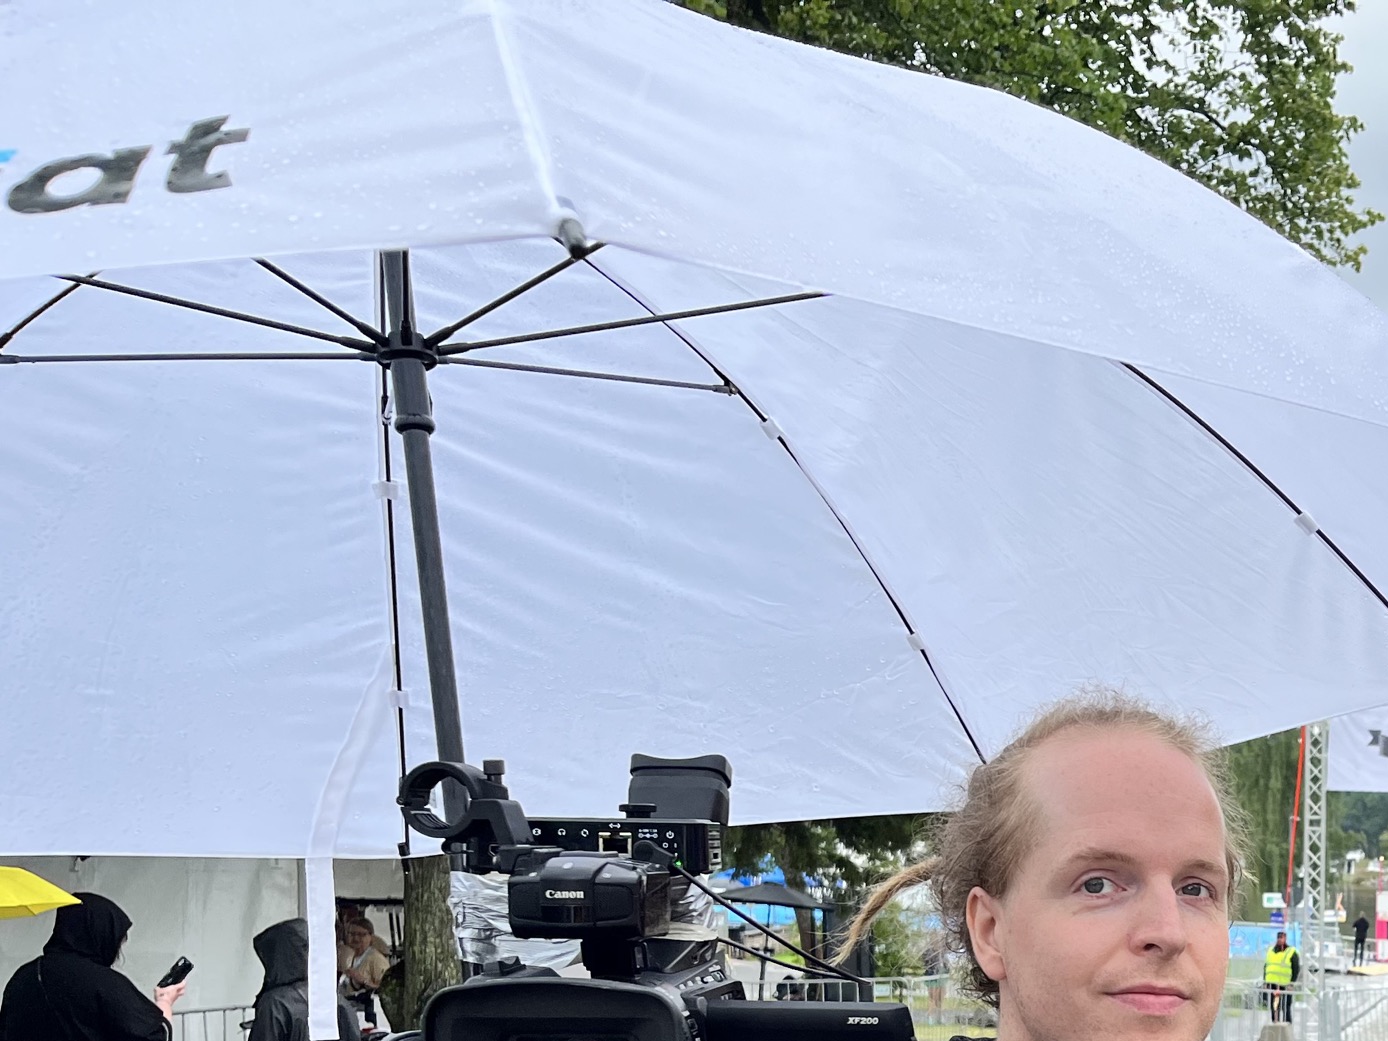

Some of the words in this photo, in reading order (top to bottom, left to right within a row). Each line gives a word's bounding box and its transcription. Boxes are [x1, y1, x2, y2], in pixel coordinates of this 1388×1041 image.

[0, 114, 250, 214] at
[545, 889, 585, 899] Canon
[846, 1016, 879, 1025] XF200
